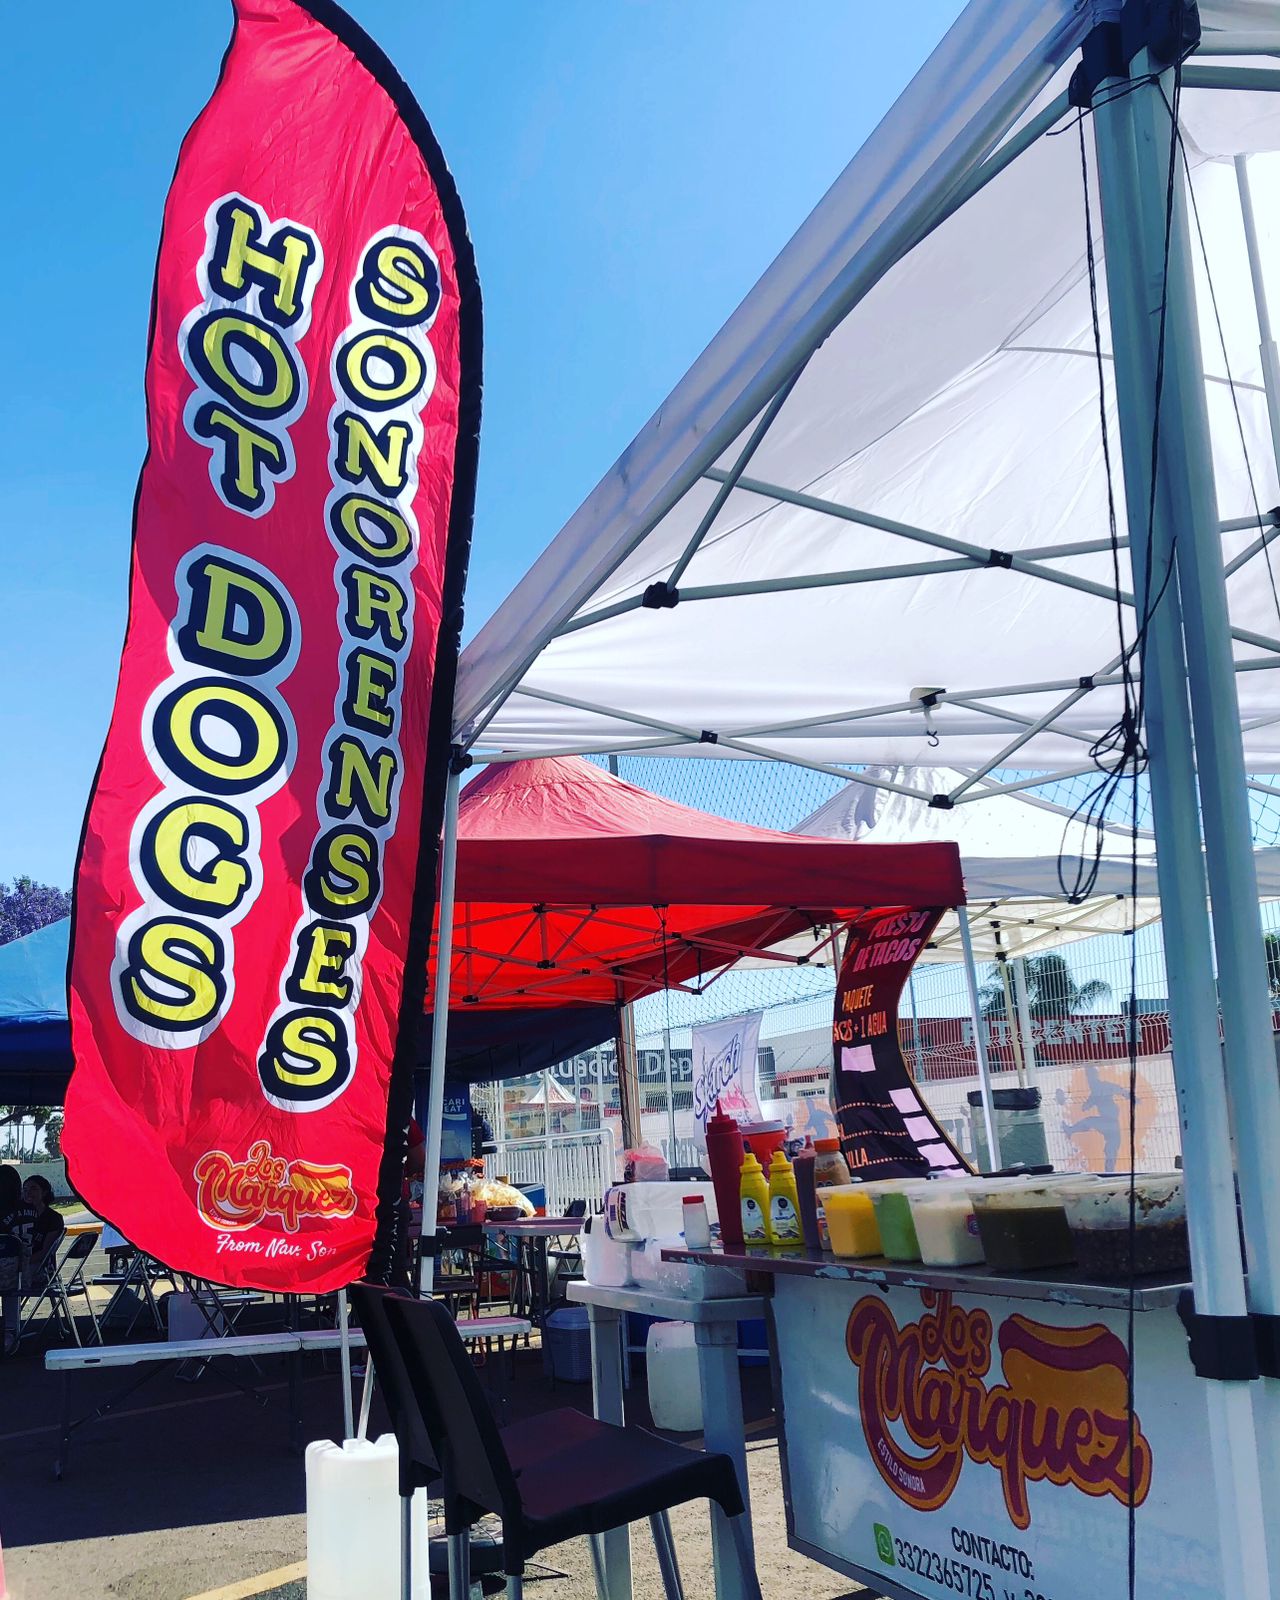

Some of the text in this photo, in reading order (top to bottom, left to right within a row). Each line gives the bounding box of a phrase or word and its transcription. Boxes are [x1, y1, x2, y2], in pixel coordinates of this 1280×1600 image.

[123, 198, 316, 1032] HOT DOGS
[258, 237, 439, 1101] SONORENSES
[853, 946, 872, 972] DE
[869, 938, 921, 968] TACOS
[868, 1011, 888, 1037] AGUA
[197, 1153, 356, 1230] Marquez
[249, 1142, 286, 1183] Los
[216, 1233, 263, 1254] From
[921, 1288, 989, 1374] Los
[847, 1298, 1149, 1527] Marquez
[878, 1437, 926, 1493] ESTILO SONORA
[894, 1537, 995, 1600] 3322365725
[951, 1526, 1035, 1581] CONTACTO:
